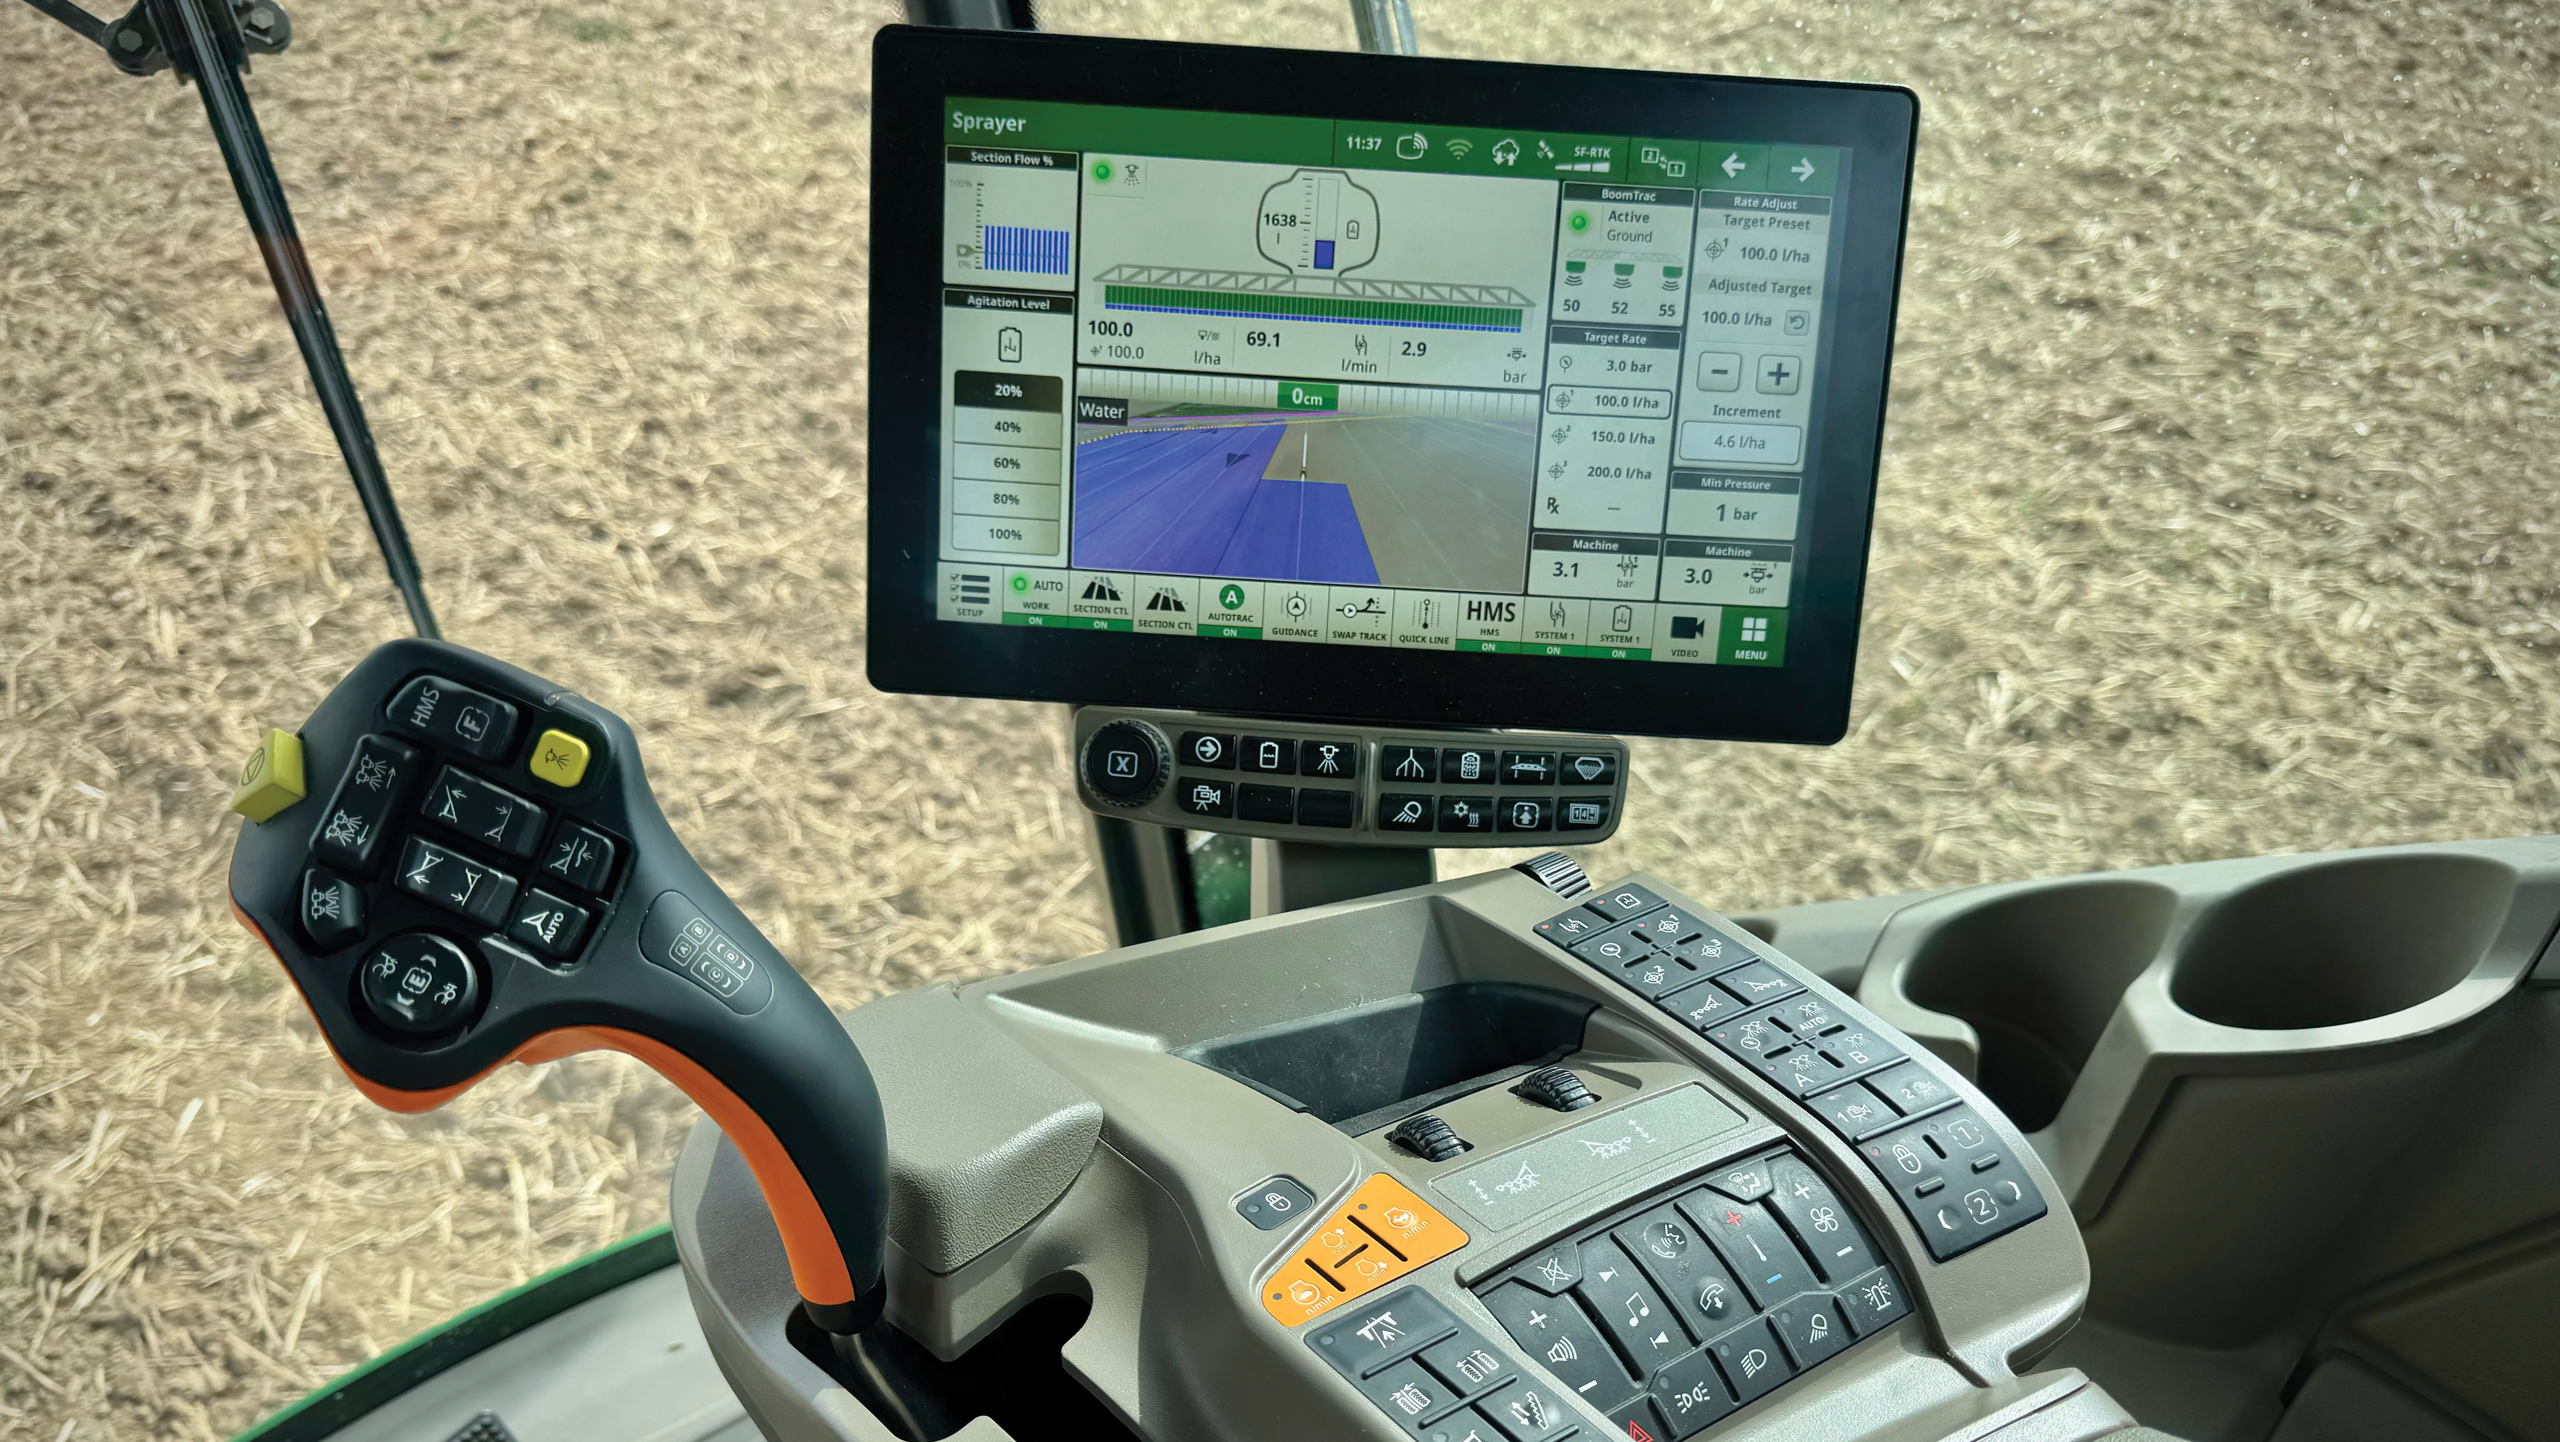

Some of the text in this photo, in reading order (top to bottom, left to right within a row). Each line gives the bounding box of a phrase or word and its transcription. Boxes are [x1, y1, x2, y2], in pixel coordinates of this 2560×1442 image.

[952, 111, 1026, 134] Sprayer
[1346, 137, 1382, 150] 11:37
[1574, 146, 1611, 158] SF-RTK
[971, 152, 1053, 167] Section Flow %
[1602, 188, 1656, 202] BoomTrac
[1734, 197, 1798, 211] Rate Adjust
[1264, 214, 1297, 227] 1638
[1608, 210, 1649, 223] Active
[1724, 214, 1810, 230] Target Preset
[1607, 229, 1652, 243] Ground
[1740, 247, 1777, 261] 100.0
[1782, 249, 1810, 263] l/ha
[958, 260, 971, 269] 0%
[1709, 279, 1811, 298] Adjusted Target
[967, 295, 1050, 310] Agitation Level
[1563, 299, 1580, 312] 50
[1611, 302, 1628, 314] 52
[1659, 304, 1675, 317] 55
[1702, 311, 1772, 326] 100.0 l/ha
[1088, 321, 1133, 337] 100.0
[1247, 331, 1280, 348] 69.1
[1585, 332, 1647, 344] Target Rate
[1108, 345, 1144, 360] 100.0
[1401, 342, 1427, 357] 2.9
[1194, 351, 1221, 365] l/ha
[1341, 359, 1377, 373] l/min
[1606, 360, 1652, 373] 3.0 bar
[1503, 370, 1527, 384] bar
[995, 384, 1022, 397] 20%
[1595, 395, 1628, 408] 100.0
[1633, 397, 1659, 409] l/ha
[1079, 403, 1125, 419] Water
[1713, 405, 1781, 418] Increment
[995, 422, 1021, 433] 40%
[1592, 431, 1625, 443] 150.0
[1629, 432, 1655, 445] l/ha
[1714, 435, 1765, 449] 4.6 l/ha
[994, 458, 1020, 469] 60%
[1587, 466, 1621, 478] 200.0
[1626, 468, 1652, 480] l/ha
[1701, 478, 1771, 490] Min Pressure
[994, 494, 1020, 505] 80%
[1716, 504, 1758, 522] 1 bar
[989, 529, 1022, 540] 100%
[1573, 539, 1618, 551] Machine
[1706, 546, 1751, 557] Machine
[1553, 562, 1579, 577] 3.1
[1684, 568, 1712, 584] 3.0
[1034, 581, 1063, 592] AUTO
[1617, 578, 1634, 588] bar
[1749, 585, 1766, 594] bar
[1023, 601, 1050, 610] WORK
[1074, 604, 1129, 615] SECTION CTL
[1467, 600, 1516, 622] HMS
[957, 608, 983, 617] SETUP
[1208, 613, 1254, 623] AUTOTRAC
[1029, 617, 1042, 625] ON
[1094, 620, 1108, 629] ON
[1138, 619, 1193, 630] SECTION CTL
[1223, 629, 1237, 637] ON
[1272, 627, 1318, 637] GUIDANCE
[1332, 631, 1387, 641] SWAP TRACK
[1480, 628, 1499, 636] HMS
[1399, 635, 1449, 645] QUICK LINE
[1600, 635, 1633, 643] SYSTEM
[1482, 643, 1495, 651] ON
[1547, 647, 1560, 655] ON
[1671, 649, 1698, 658] VIDEO
[1612, 650, 1626, 658] ON
[1735, 650, 1767, 660] MENU
[411, 687, 439, 727] HMS
[463, 715, 481, 733] F
[1116, 756, 1130, 772] X
[543, 912, 564, 944] AUTO
[694, 926, 702, 935] B
[680, 945, 688, 954] A
[409, 973, 427, 988] E
[712, 970, 720, 978] C
[1799, 1017, 1825, 1032] AUTO
[1848, 1051, 1869, 1064] B
[1793, 1072, 1815, 1087] A
[1901, 1089, 1915, 1099] 2
[1837, 1112, 1848, 1122] 1
[1958, 1127, 1973, 1140] 1
[1974, 1198, 1990, 1216] 2
[1403, 1220, 1430, 1239] n/min
[1306, 1294, 1335, 1315] n/min
